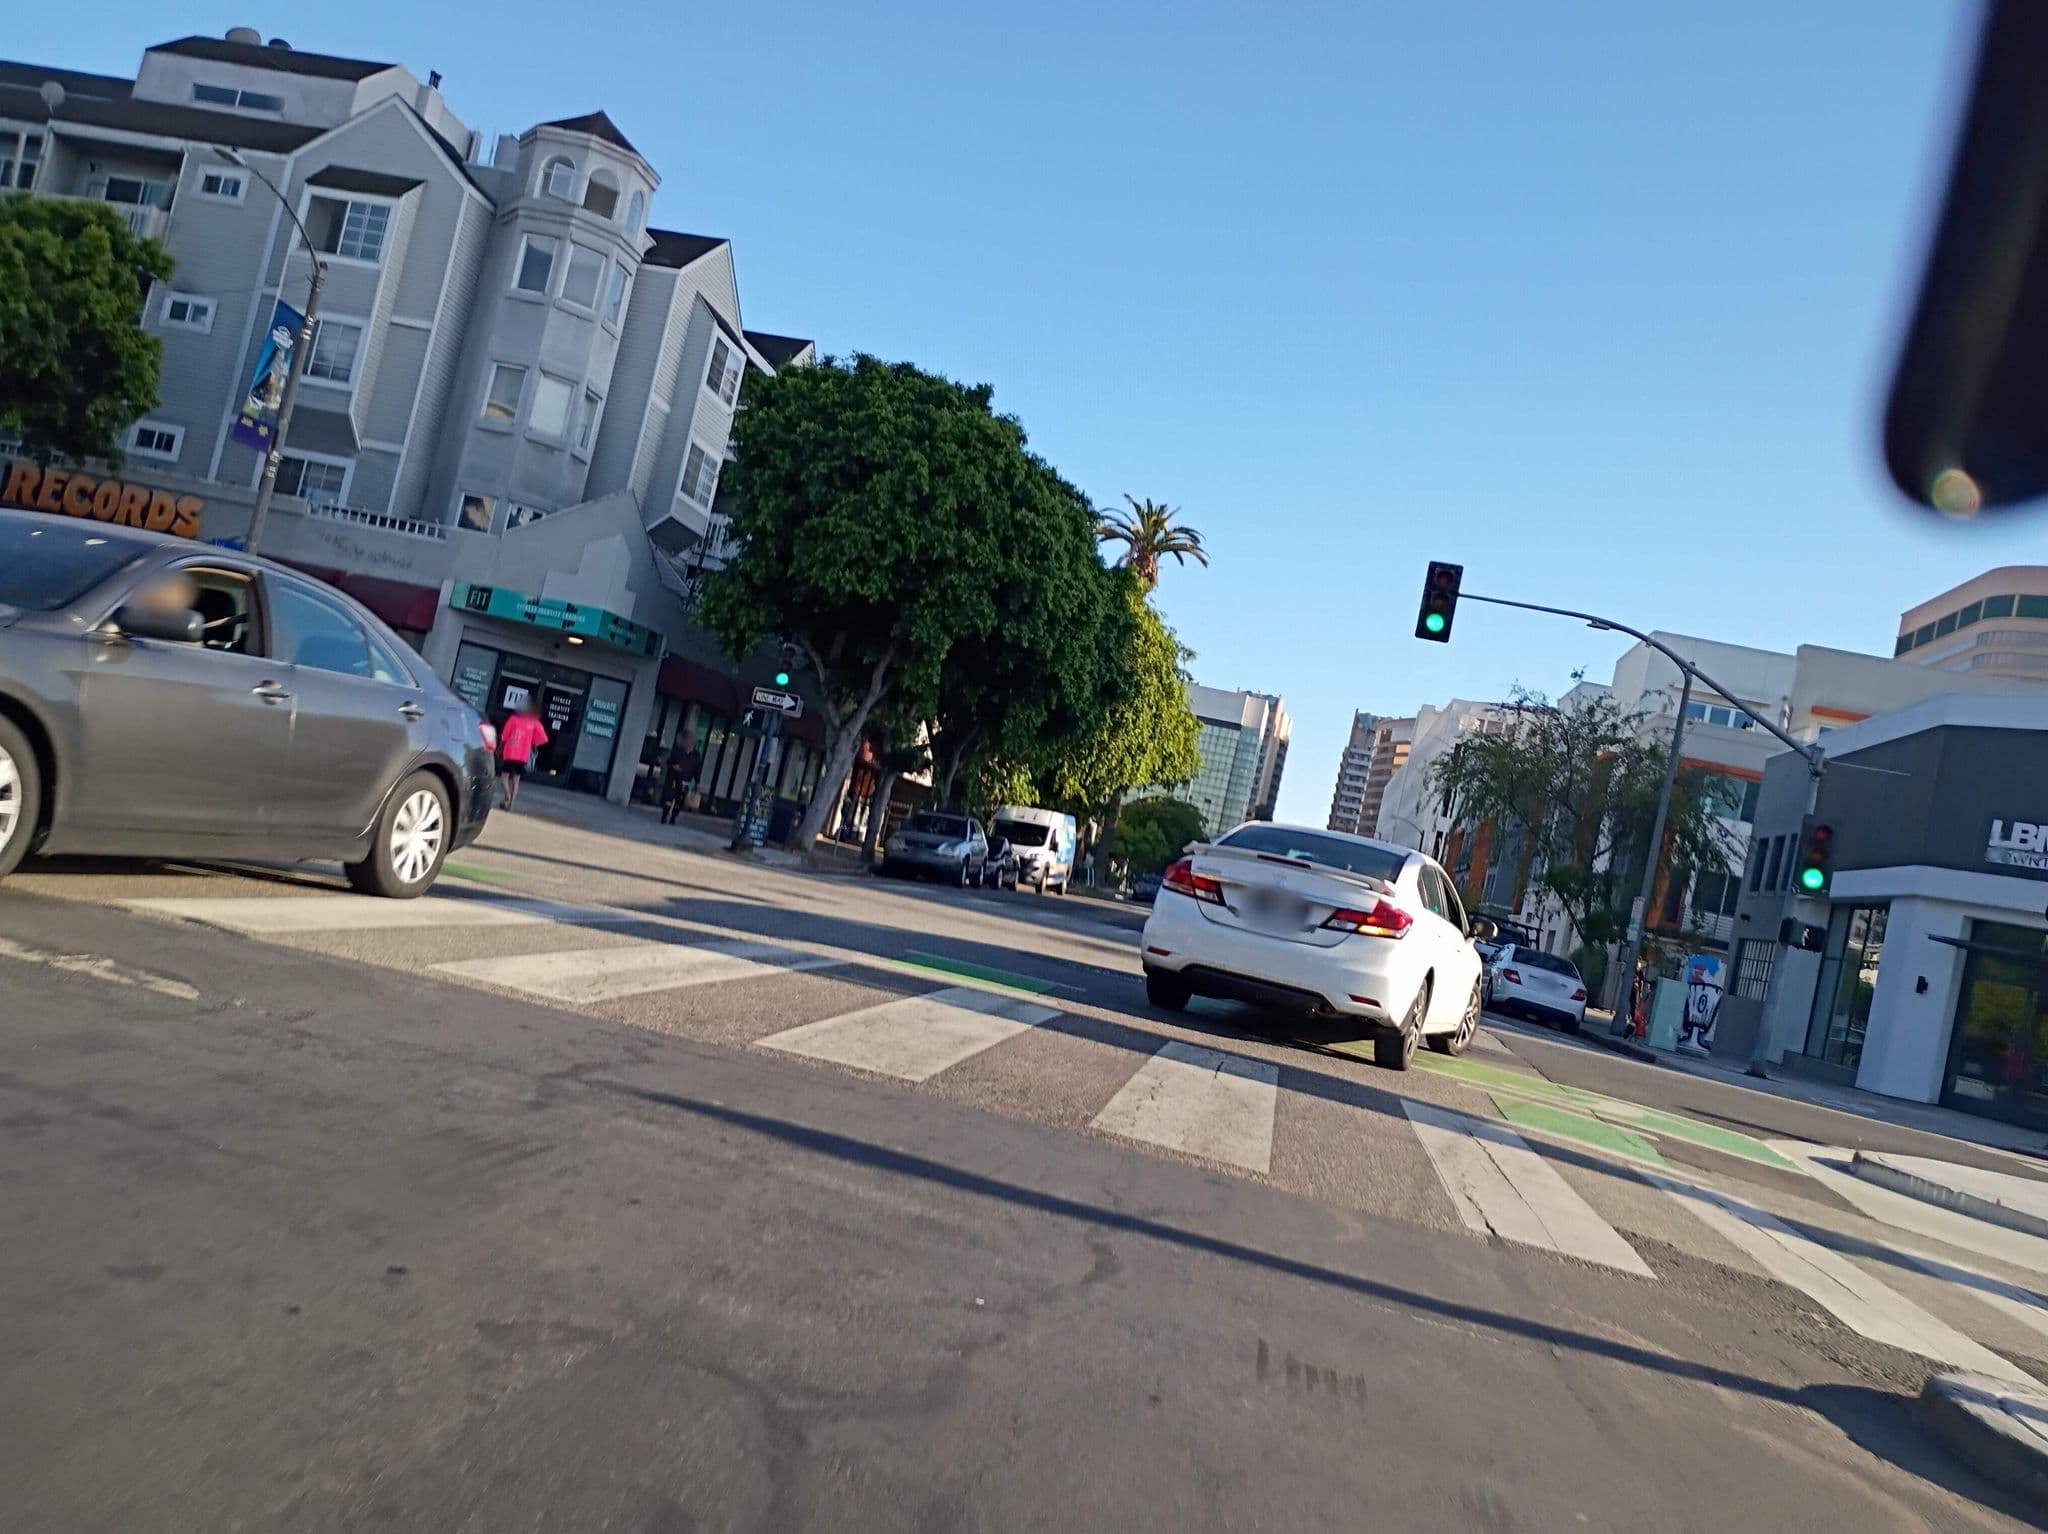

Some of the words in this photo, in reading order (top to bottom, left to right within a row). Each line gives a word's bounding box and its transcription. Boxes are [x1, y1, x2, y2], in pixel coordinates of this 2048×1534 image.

[3, 462, 205, 538] RECORDS
[471, 590, 489, 607] FIT
[757, 692, 770, 702] ONE
[771, 695, 785, 706] WAY
